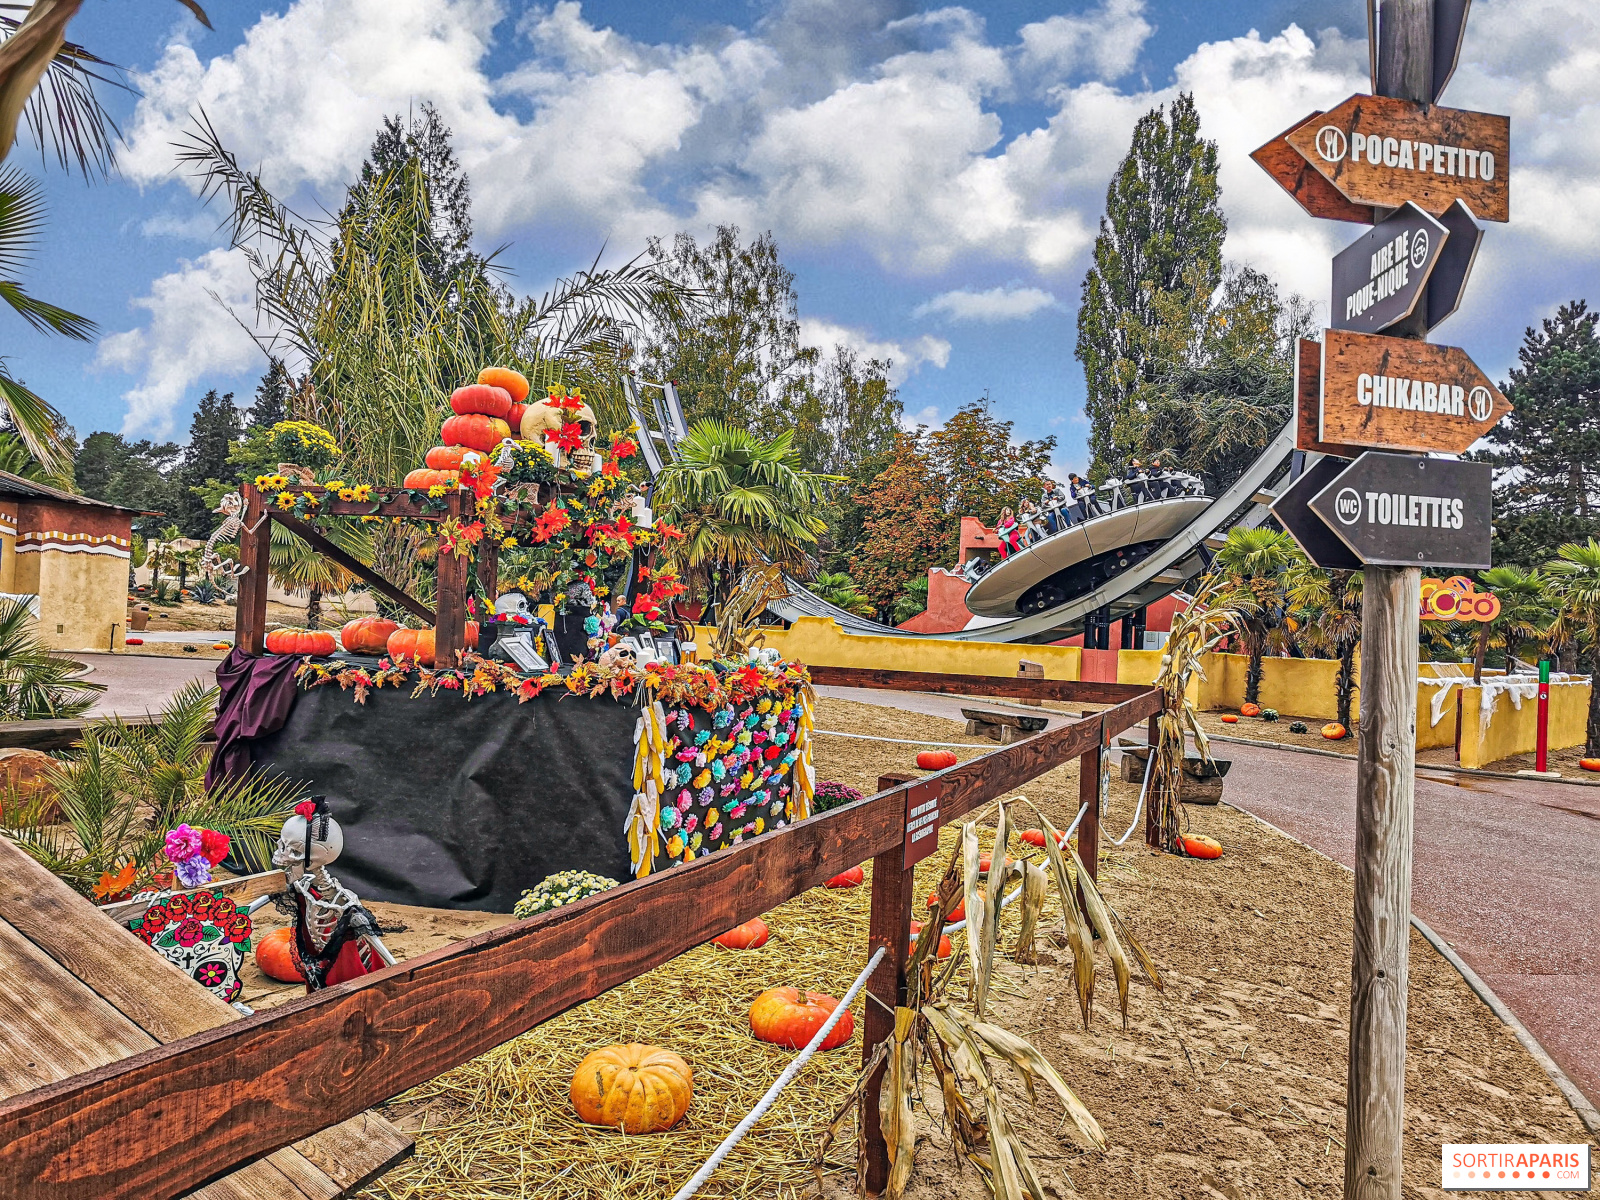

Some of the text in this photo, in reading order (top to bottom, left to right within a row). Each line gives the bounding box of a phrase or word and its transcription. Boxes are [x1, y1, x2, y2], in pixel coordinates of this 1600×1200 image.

[1350, 132, 1495, 181] POCA'PETITO
[1370, 230, 1409, 278] AIRE DE
[1346, 259, 1409, 321] PIQUE-NIQUE
[1357, 373, 1465, 416] CHIKABAR
[1340, 499, 1358, 515] WC
[1366, 492, 1464, 530] TOILETTES
